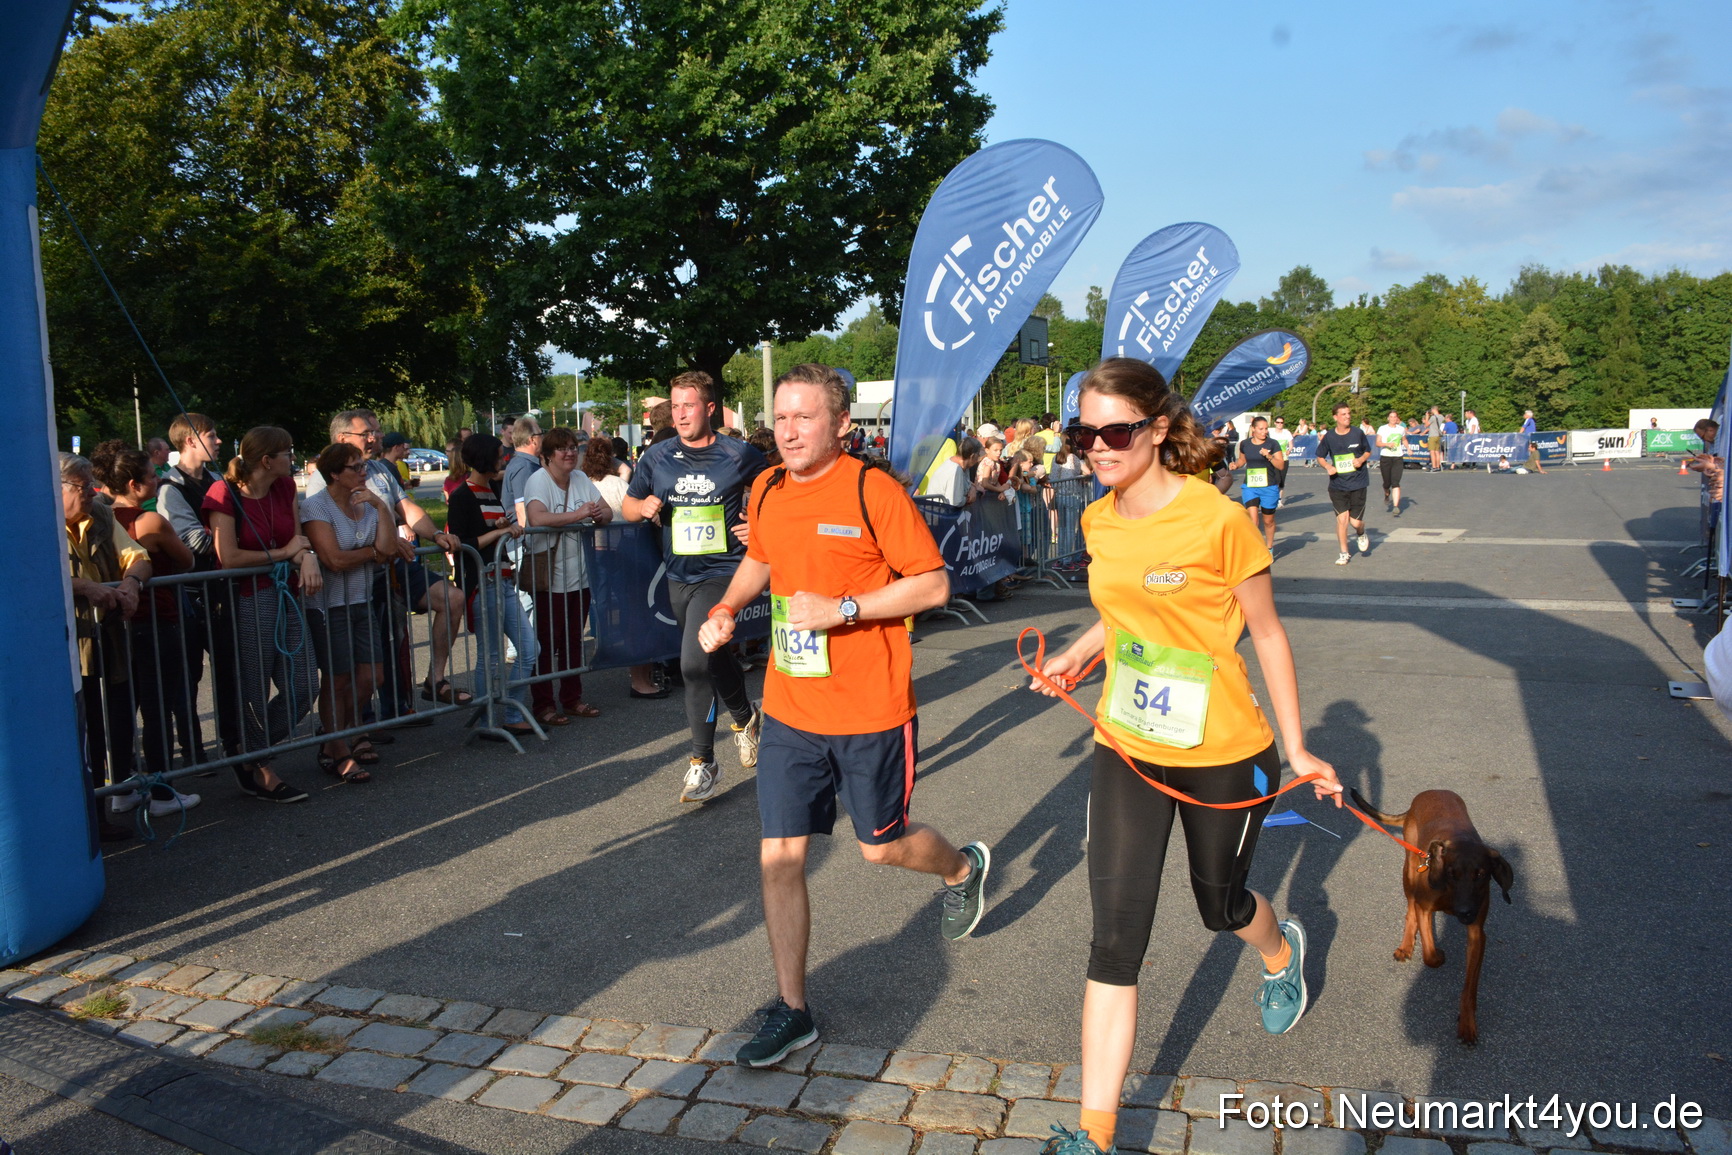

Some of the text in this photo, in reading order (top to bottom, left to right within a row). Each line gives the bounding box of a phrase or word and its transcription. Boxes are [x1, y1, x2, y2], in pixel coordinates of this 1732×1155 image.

[950, 176, 1060, 325] Fischer
[987, 205, 1072, 324] AUTOMOBILE
[1136, 246, 1210, 354] Fischer
[1162, 265, 1219, 352] AUTOMOBILE
[1194, 366, 1276, 416] Frischmann
[1246, 380, 1267, 396] Druck
[1280, 360, 1304, 377] Medien
[1473, 445, 1517, 453] Fischer
[1598, 436, 1625, 449] swn
[1651, 433, 1673, 444] AOK
[1339, 460, 1352, 469] 695
[1250, 475, 1264, 483] 706
[690, 495, 711, 505] guad
[684, 525, 716, 541] 179
[774, 626, 819, 655] 1034
[1133, 679, 1171, 716] 54
[1120, 707, 1138, 721] Tamara
[1138, 716, 1186, 734] Brandenburger
